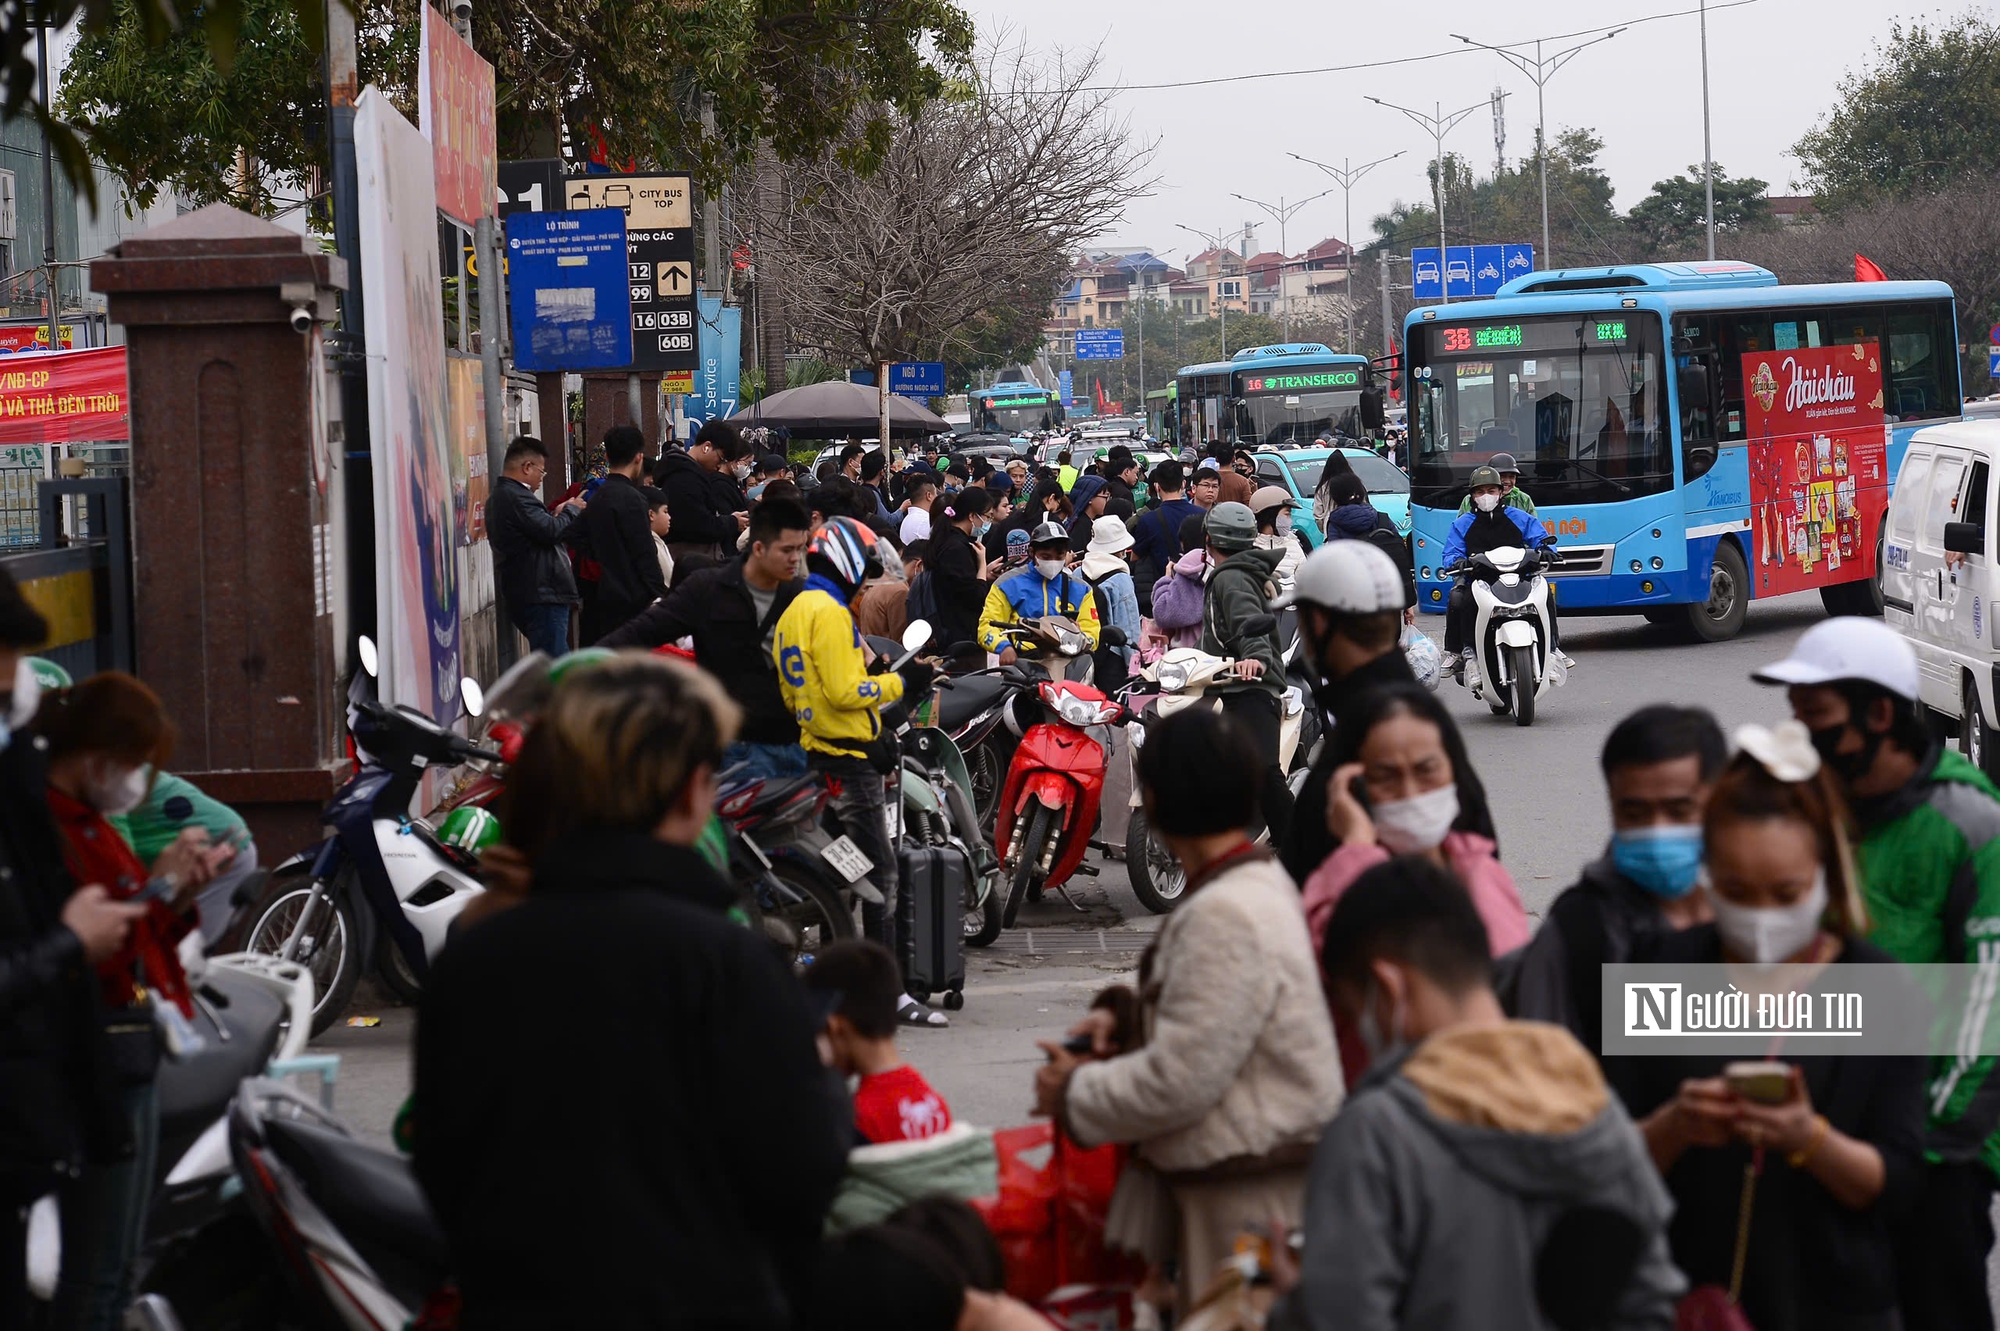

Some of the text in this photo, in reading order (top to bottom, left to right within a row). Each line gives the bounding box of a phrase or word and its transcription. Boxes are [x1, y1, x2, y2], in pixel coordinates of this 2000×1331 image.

[639, 189, 683, 198] CITY BUS
[654, 200, 673, 208] TOP
[557, 220, 580, 231] TRÌNH
[652, 231, 674, 240] CÁC
[631, 265, 649, 278] 12
[631, 287, 650, 300] 99
[637, 313, 689, 327] 16 03B
[662, 336, 690, 349] 60B
[920, 367, 925, 378] 3
[704, 358, 717, 408] Service
[1248, 373, 1357, 391] 16 TRANSERCO
[6, 396, 25, 416] VÀ
[28, 393, 56, 415] THẢ
[58, 393, 86, 414] ĐÈN
[88, 392, 120, 412] TRỜI
